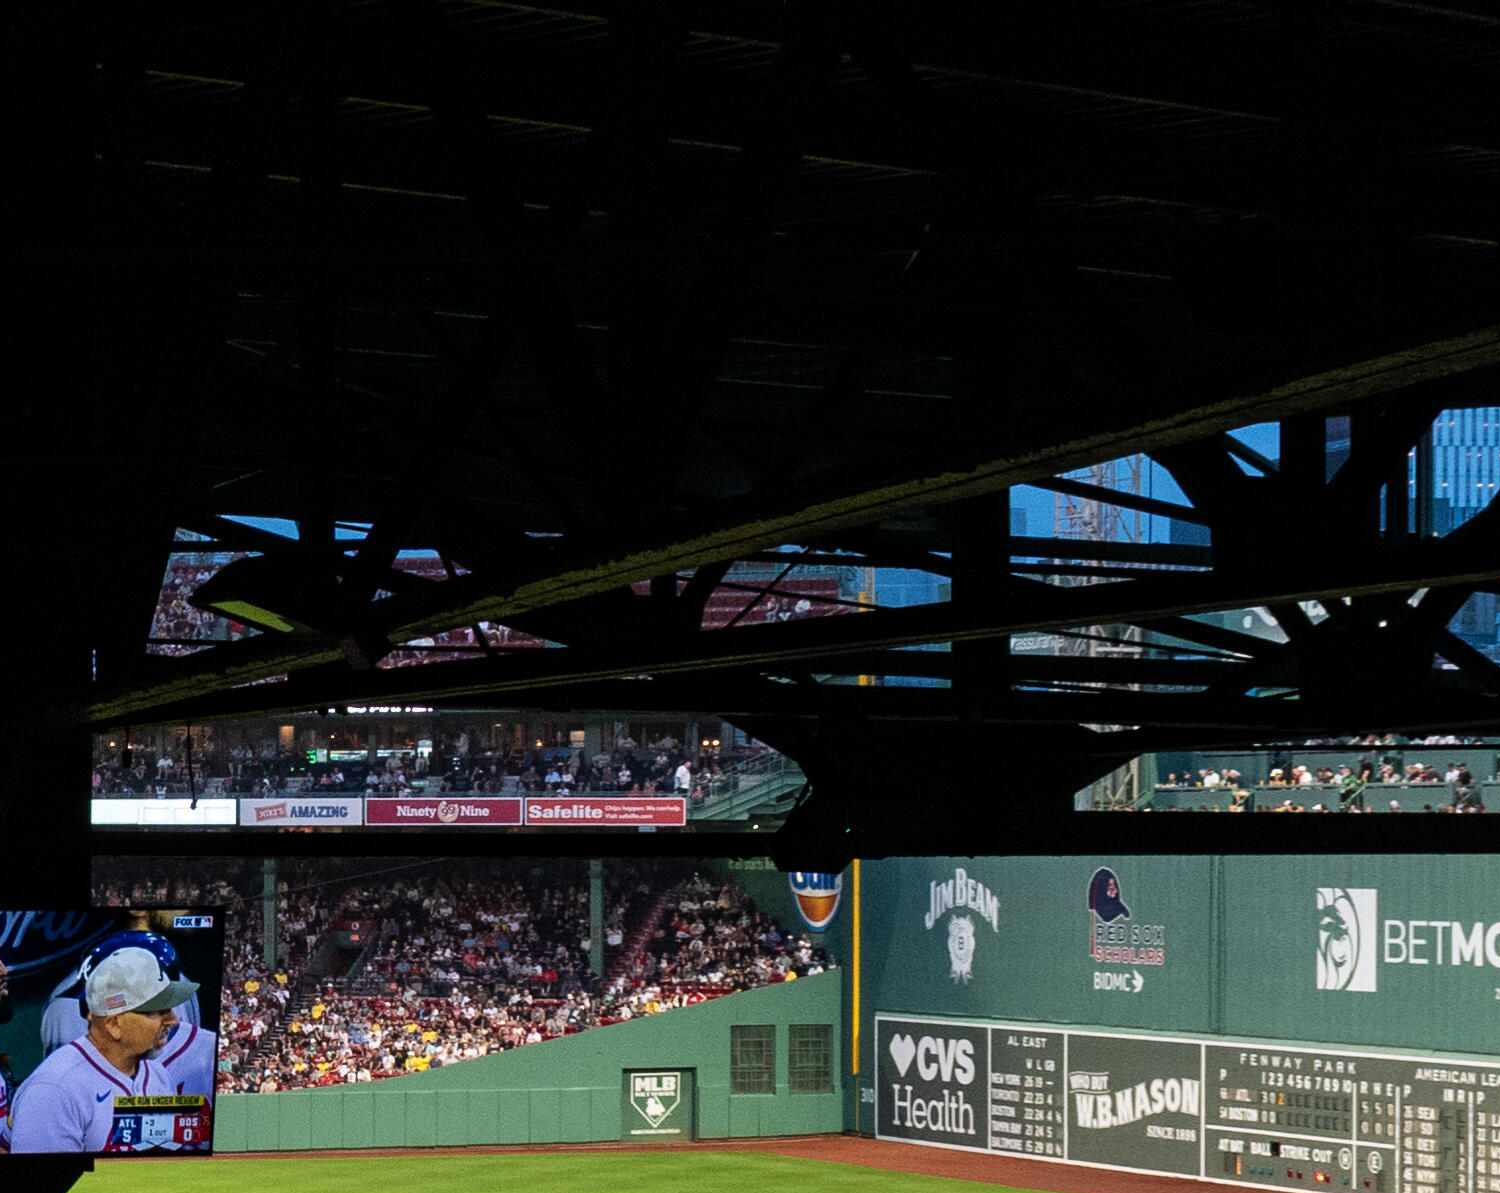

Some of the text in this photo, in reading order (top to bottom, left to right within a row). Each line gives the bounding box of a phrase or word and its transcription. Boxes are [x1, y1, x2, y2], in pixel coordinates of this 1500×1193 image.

[289, 805, 349, 818] AMAZING
[396, 805, 490, 818] Ninety Nine
[528, 804, 604, 819] Safelite
[925, 868, 1000, 933] JIM BEAM
[175, 917, 192, 927] FOX
[1095, 925, 1166, 946] RED SOX
[1094, 946, 1165, 966] SCHOLARS
[1093, 971, 1131, 992] BIDMC
[1006, 1035, 1049, 1049] AL EAST
[916, 1035, 976, 1085] CVS
[1240, 1053, 1357, 1075] FENWAY PARK
[635, 1076, 677, 1092] MLB
[1219, 1068, 1395, 1097] P 4 5 6 7 8 9 R E
[1414, 1067, 1476, 1085] AMERICAN
[118, 1095, 200, 1106] HOME RUN UNDER REVIEW
[1075, 1077, 1200, 1129] W.B.MASON
[1277, 1092, 1285, 1106] 2
[1403, 1085, 1412, 1098] P
[1457, 1089, 1466, 1103] R
[1476, 1091, 1485, 1105] P
[892, 1083, 976, 1136] Health
[1228, 1107, 1259, 1122] BOSTON
[1416, 1105, 1436, 1121] SEA
[118, 1117, 198, 1128] ATL BOS
[122, 1130, 132, 1143] 5
[183, 1129, 193, 1142] 0
[1146, 1124, 1175, 1141] SINCE
[1250, 1141, 1334, 1163] BALL STRIKE OUT
[1416, 1138, 1436, 1152] DET
[1416, 1153, 1436, 1168] TOR
